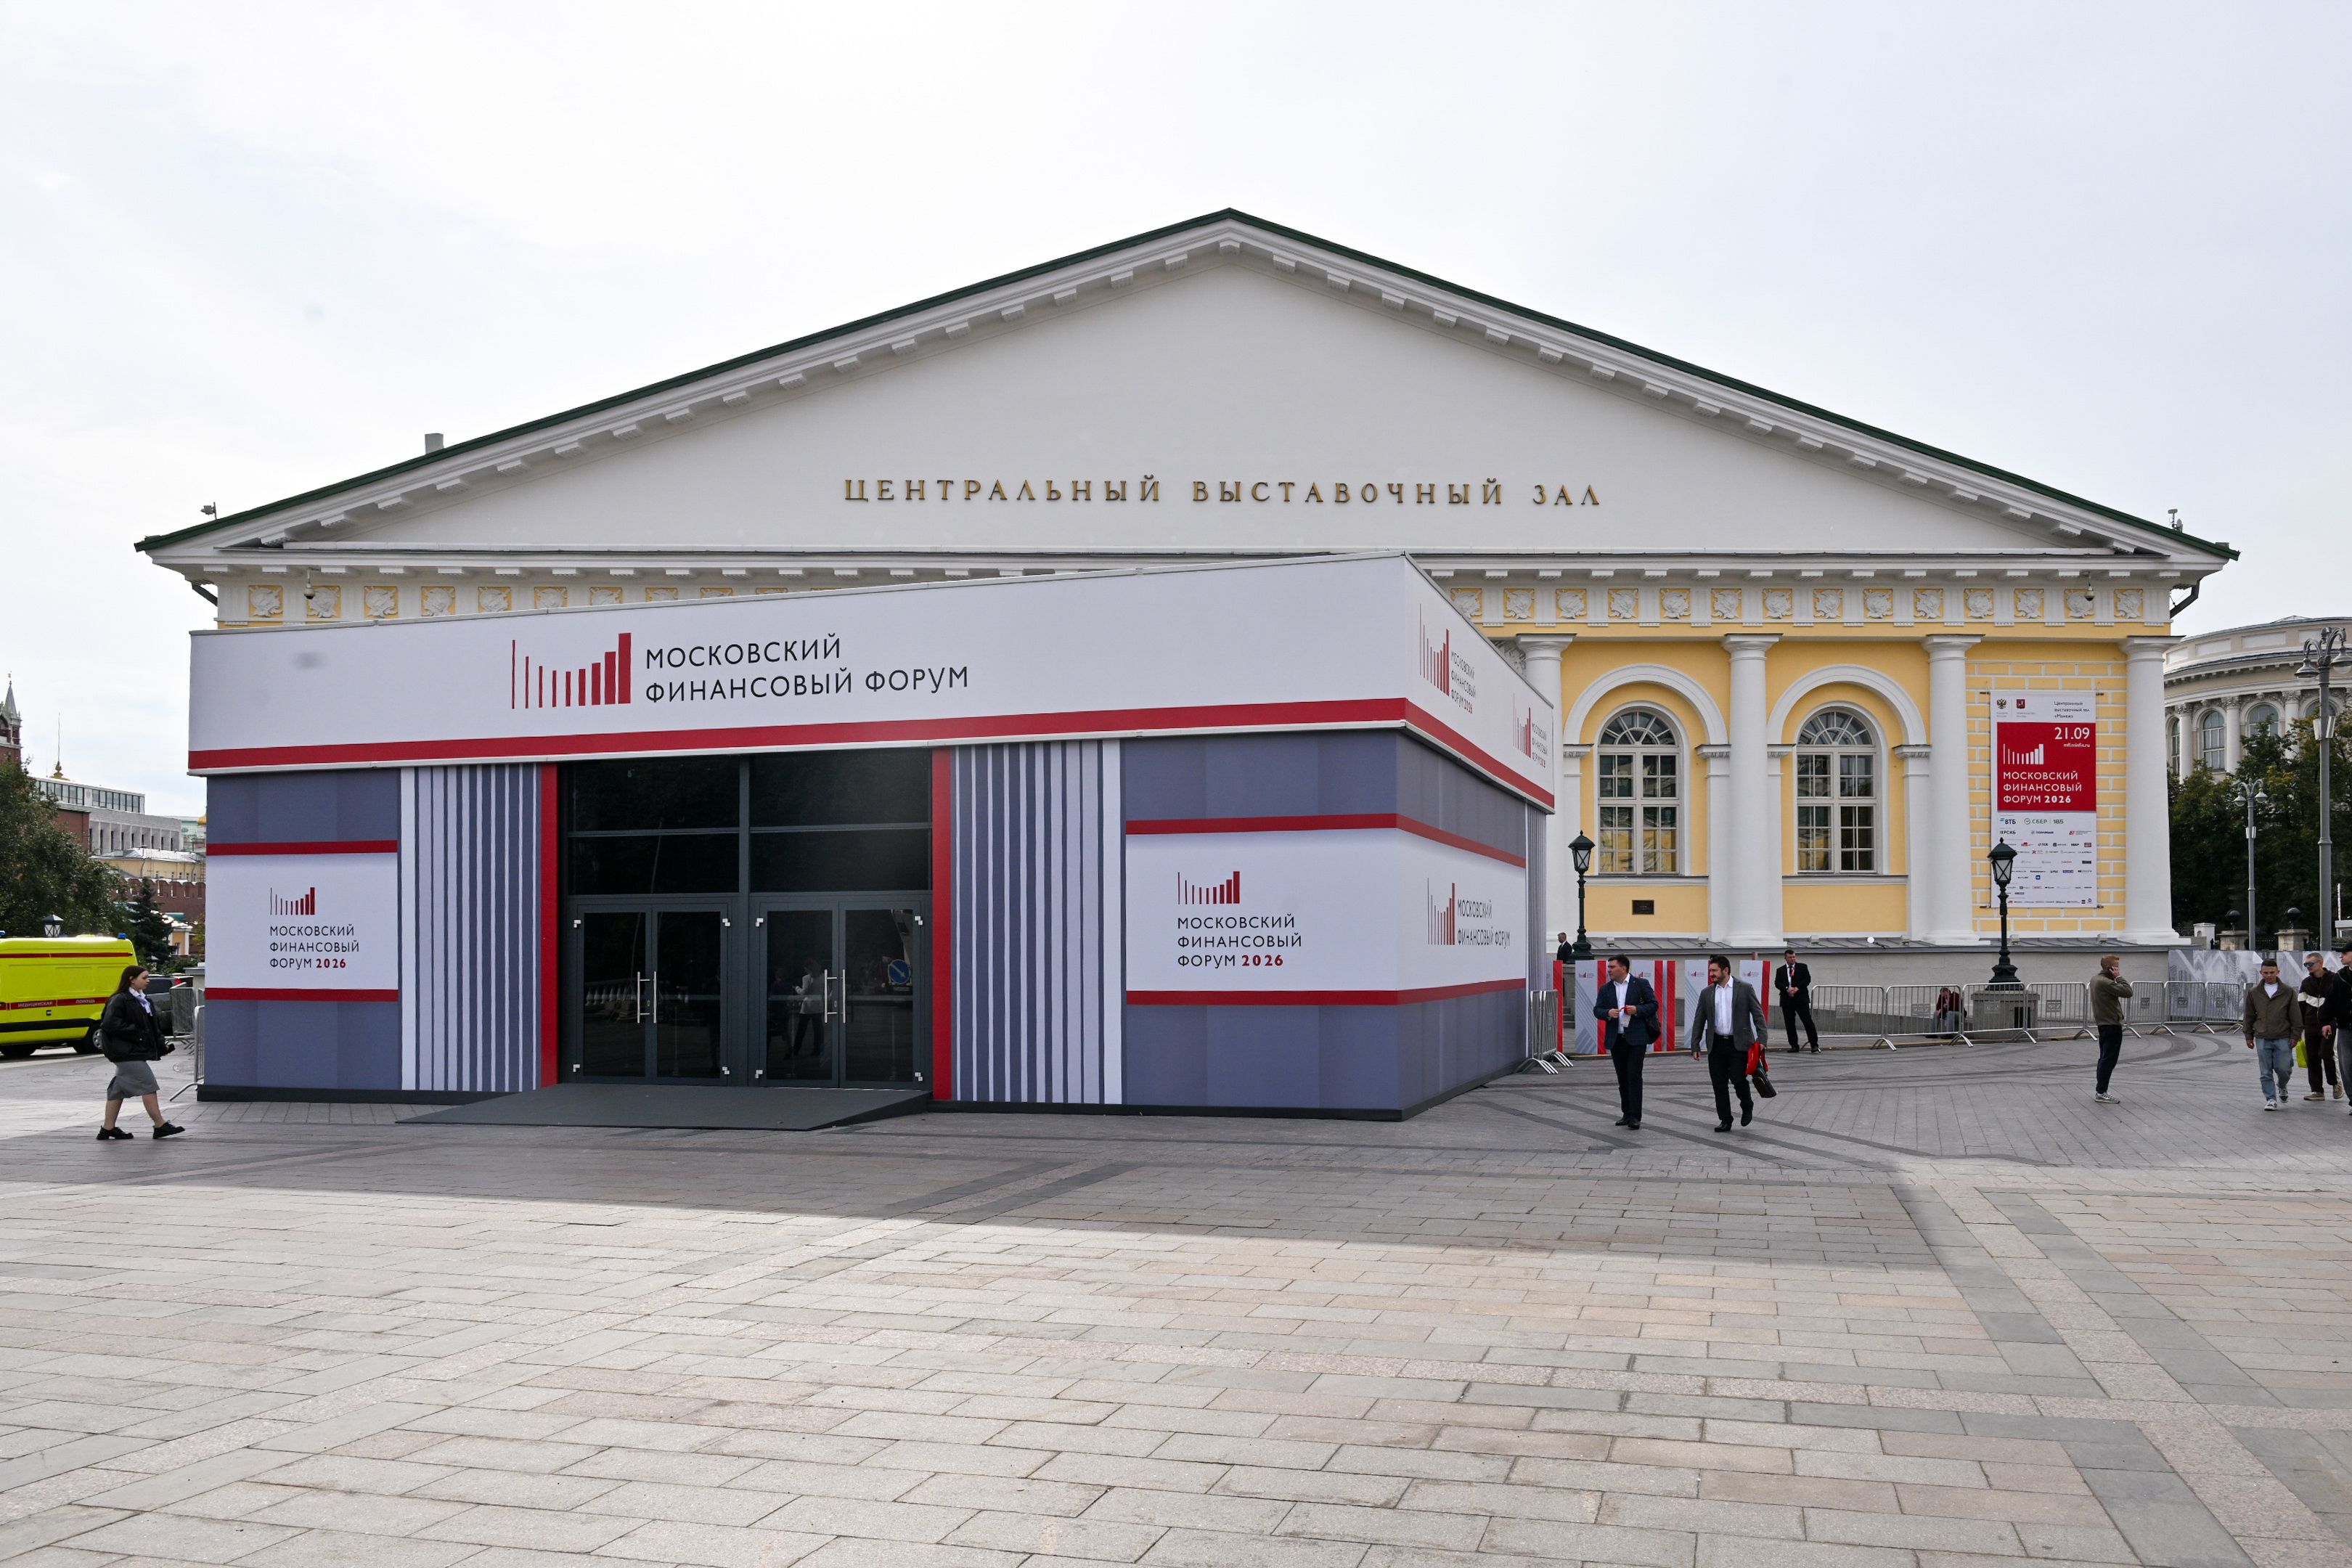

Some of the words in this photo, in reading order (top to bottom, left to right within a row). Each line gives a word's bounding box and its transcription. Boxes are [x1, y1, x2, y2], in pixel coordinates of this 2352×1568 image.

[844, 474, 1160, 503] ЦЕНТРАЛЬНЫЙ
[1192, 477, 1502, 505] ВЫСТАВОЧНЫЙ
[1532, 484, 1600, 506] ЗАЛ
[646, 633, 841, 669] МОСКОВСКИЙ
[646, 667, 853, 703] ФИНАНСОВЫЙ
[865, 666, 968, 694] ФОРУМ
[2054, 727, 2091, 740] 21.09
[2003, 770, 2078, 780] МОСКОВСКИЙ
[2003, 782, 2082, 792] ФИНАНСОВЫЙ
[2003, 795, 2041, 804] ФОРУМ
[2043, 795, 2072, 804] 2026
[1458, 899, 1493, 919] МОСКОВСКИЙ
[1177, 913, 1295, 929] МОСКОВСКИЙ
[269, 923, 354, 936] МОСКОВСКИЙ
[1177, 933, 1302, 948] ФИНАНСОВЫЙ
[1458, 926, 1494, 945] ФИНАНСОВЫЙ
[1495, 930, 1511, 949] ФОРУМ
[269, 940, 359, 952] ФИНАНСОВЫЙ
[269, 958, 312, 971] ФОРУМ
[316, 958, 346, 968] 2026
[1177, 954, 1236, 969] ФОРУМ
[1241, 954, 1284, 967] 2026
